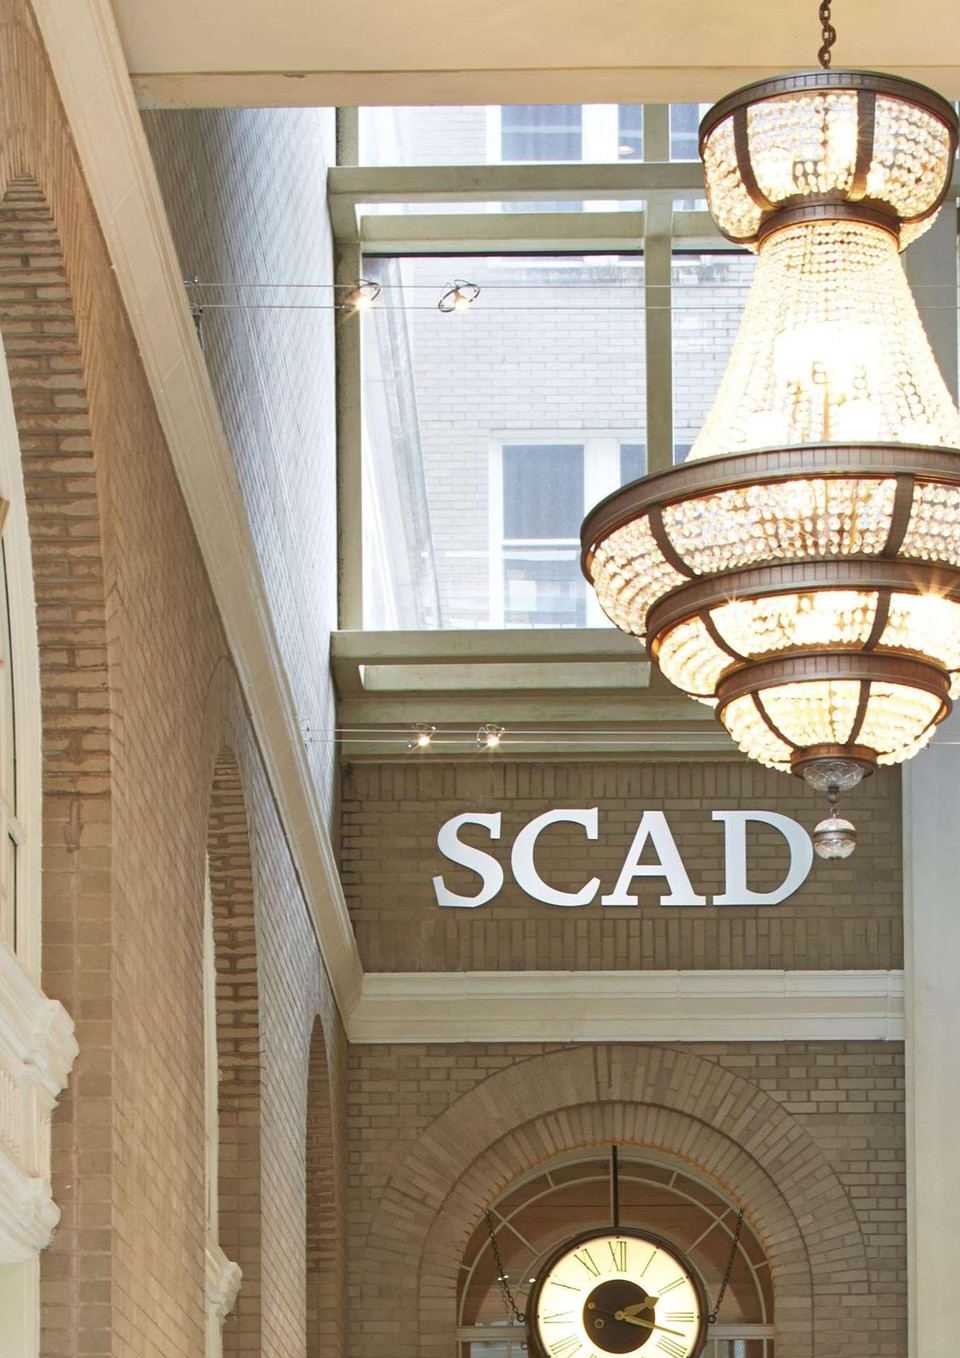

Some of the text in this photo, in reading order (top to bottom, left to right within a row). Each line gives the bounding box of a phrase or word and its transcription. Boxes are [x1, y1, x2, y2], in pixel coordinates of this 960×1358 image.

[432, 807, 814, 908] SCAD
[574, 1248, 601, 1281] XI
[608, 1241, 627, 1272] XII
